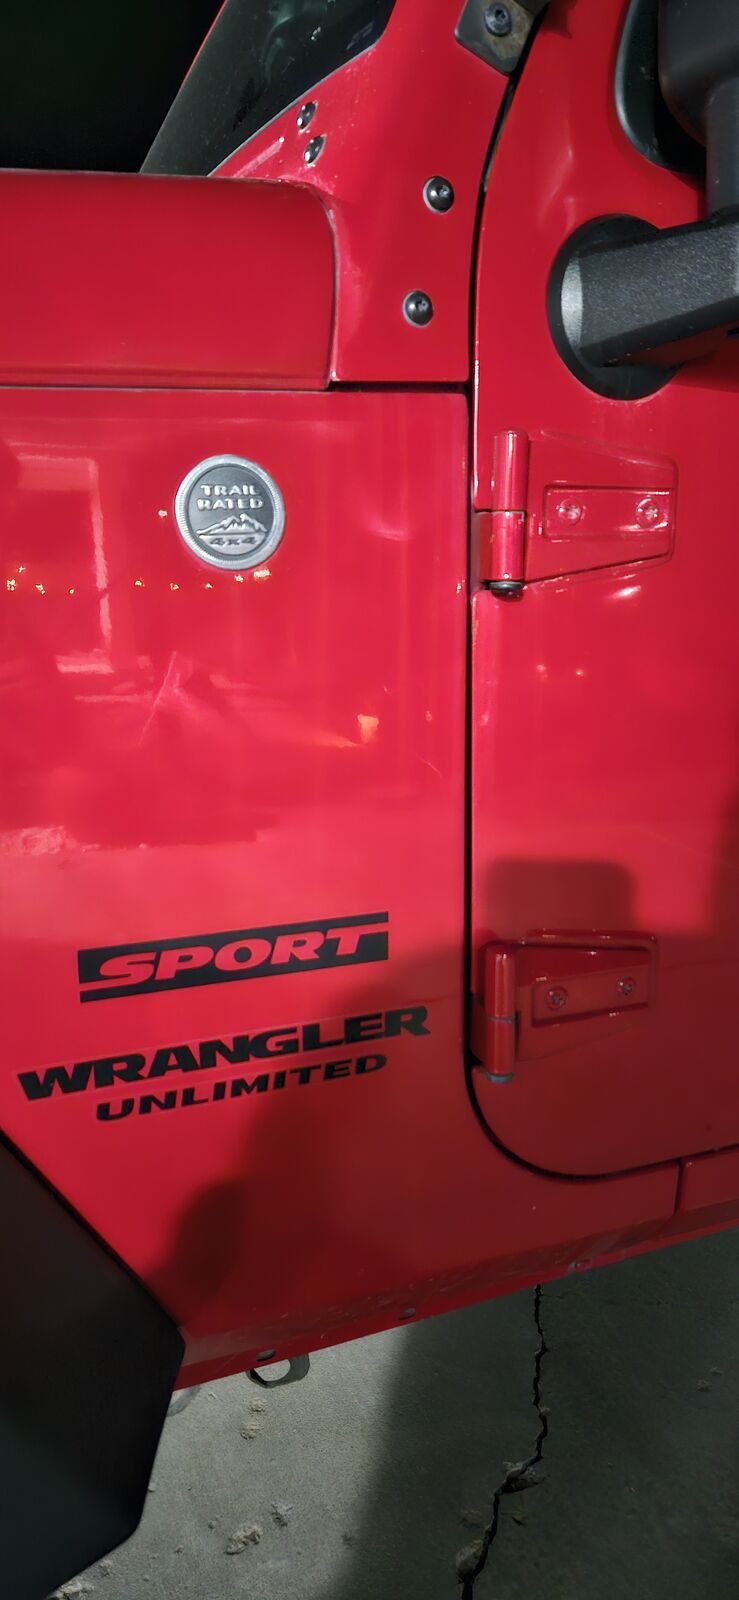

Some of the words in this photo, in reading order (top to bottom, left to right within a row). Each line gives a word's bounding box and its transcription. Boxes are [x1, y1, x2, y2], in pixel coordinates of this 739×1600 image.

[197, 498, 264, 510] RATED
[200, 484, 260, 497] TRAIL
[84, 921, 389, 989] SPORT
[17, 1005, 431, 1101] WRANGLER
[96, 1054, 388, 1121] UNLIMITED
